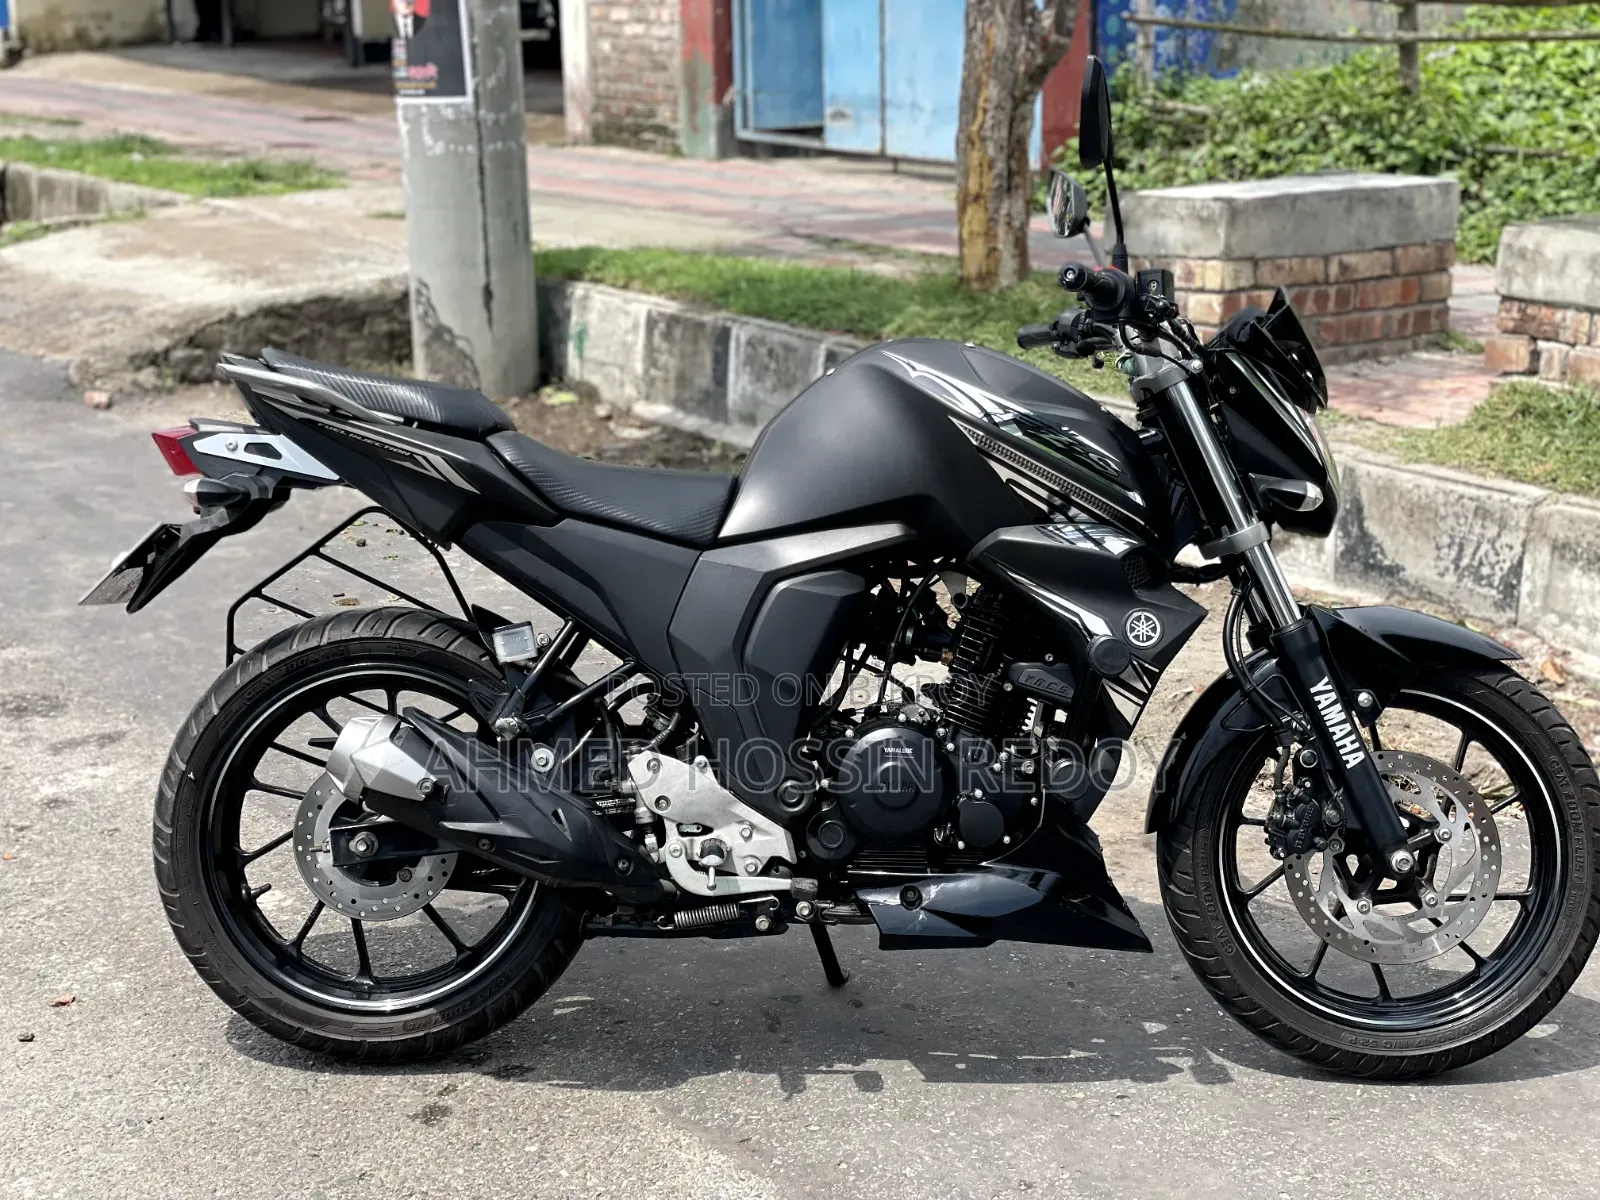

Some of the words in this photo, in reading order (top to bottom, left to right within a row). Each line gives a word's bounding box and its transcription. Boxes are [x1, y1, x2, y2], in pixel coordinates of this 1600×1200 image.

[317, 423, 347, 436] FUEL
[348, 432, 412, 456] INJECTION
[1310, 676, 1365, 769] YAMAHA
